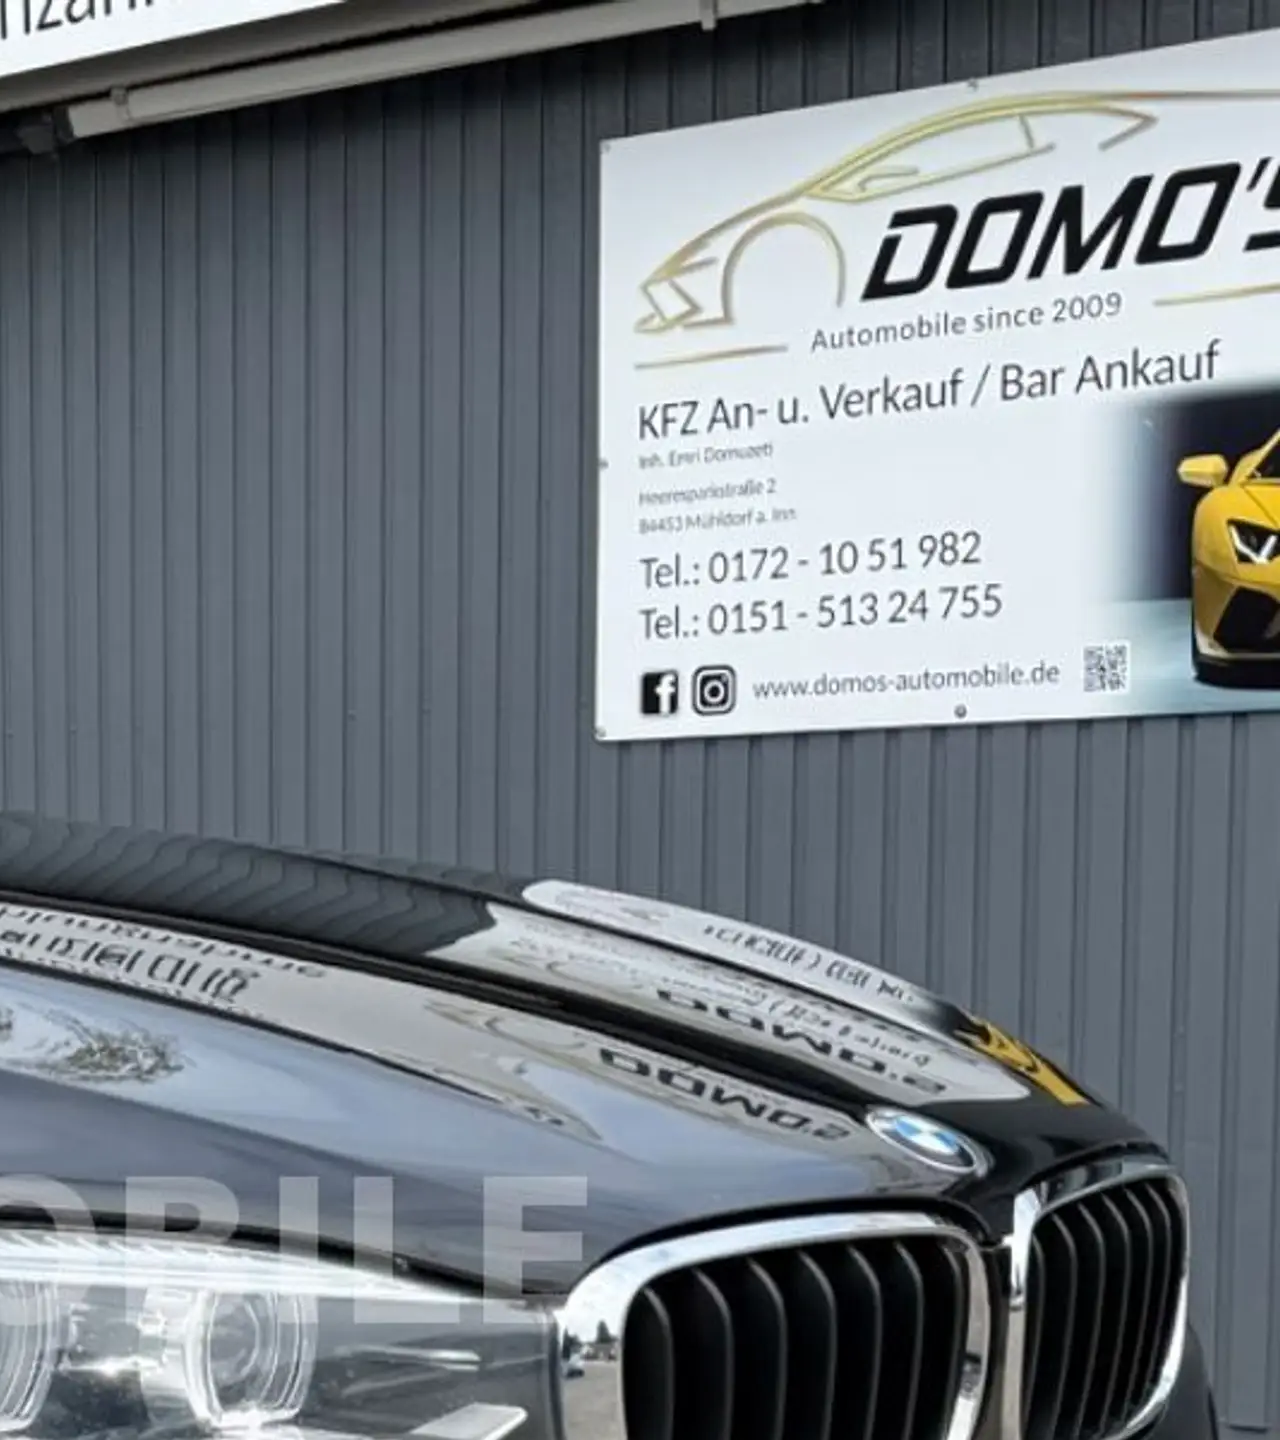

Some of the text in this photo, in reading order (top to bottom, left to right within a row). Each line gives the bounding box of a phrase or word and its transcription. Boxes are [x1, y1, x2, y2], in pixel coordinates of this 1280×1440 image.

[810, 292, 1123, 353] Automobile since 2009
[639, 401, 699, 440] KFZ
[707, 397, 768, 433] An-
[777, 396, 809, 425] u.
[819, 367, 964, 420] Verkauf
[1001, 363, 1066, 402] Bar
[1075, 338, 1222, 395] Ankauf
[767, 478, 777, 494] 2
[639, 553, 701, 589] Tel.:
[708, 546, 789, 585] 0172
[820, 540, 859, 576] 10
[867, 537, 907, 573] 51
[918, 530, 982, 569] 982
[639, 604, 701, 641] Tel.:
[708, 599, 788, 636] 0151
[817, 591, 879, 628] 513
[888, 588, 928, 624] 24
[938, 583, 1003, 621] 755
[752, 660, 1060, 699] www.domos-automobile.de
